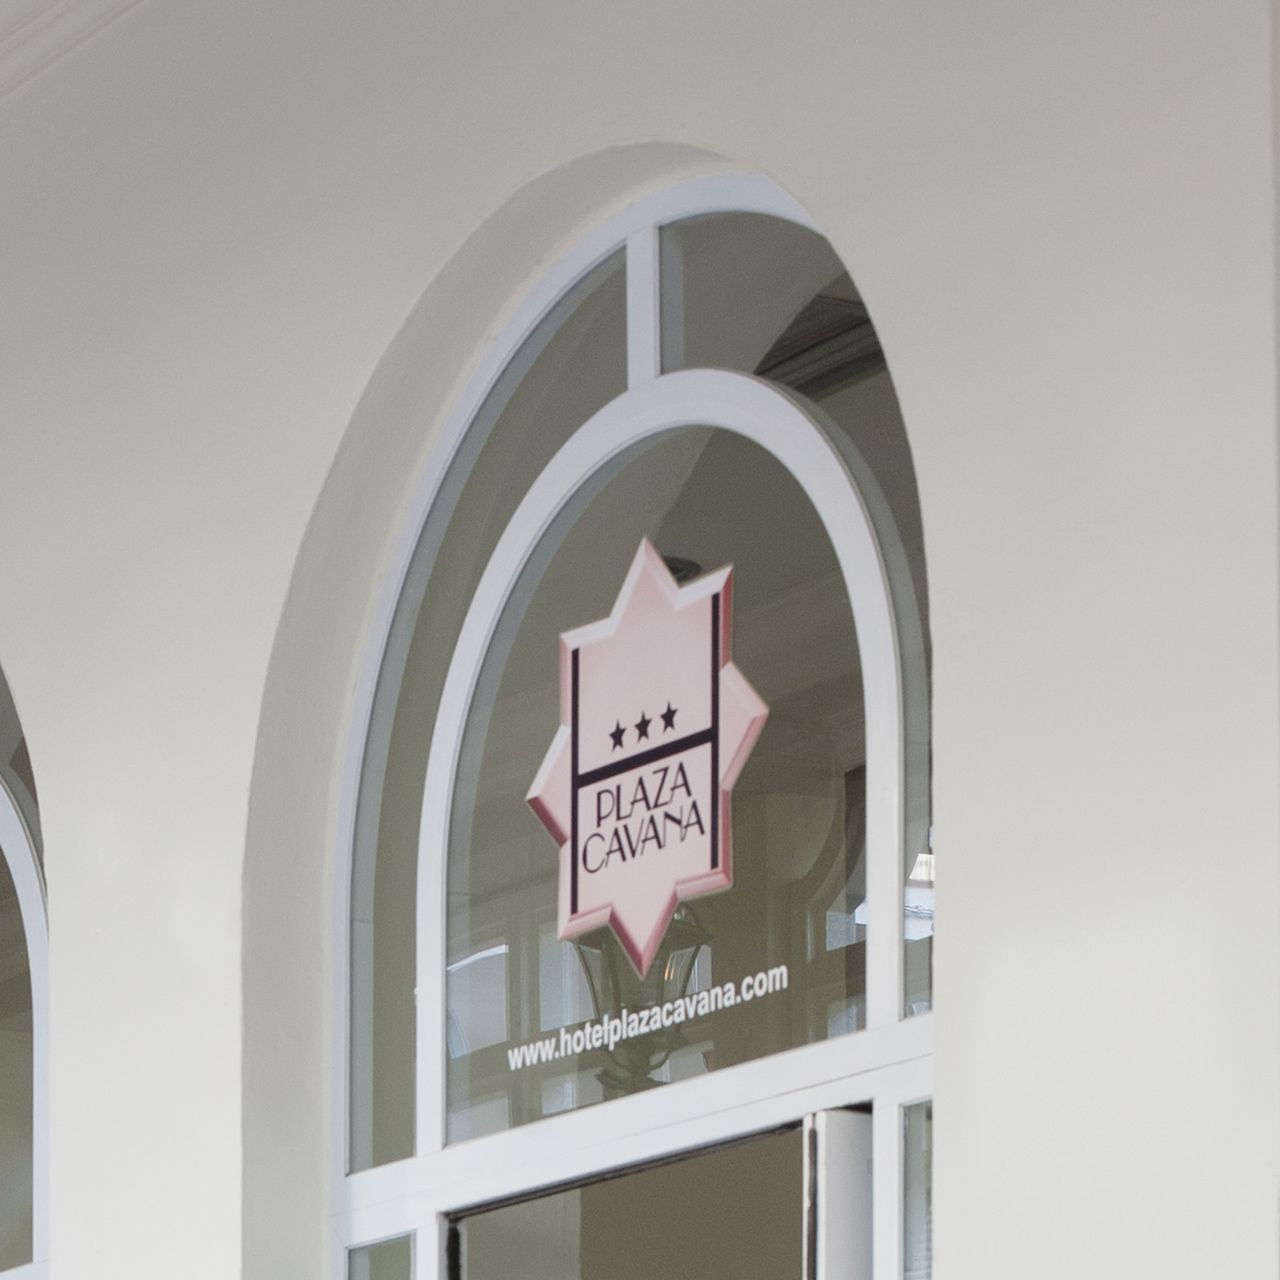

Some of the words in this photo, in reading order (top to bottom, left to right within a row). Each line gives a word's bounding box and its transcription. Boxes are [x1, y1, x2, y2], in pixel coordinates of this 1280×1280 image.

[597, 762, 692, 828] PLAZA
[582, 800, 705, 873] CAVANA
[507, 964, 788, 1071] www.hotelplazacavana.com
